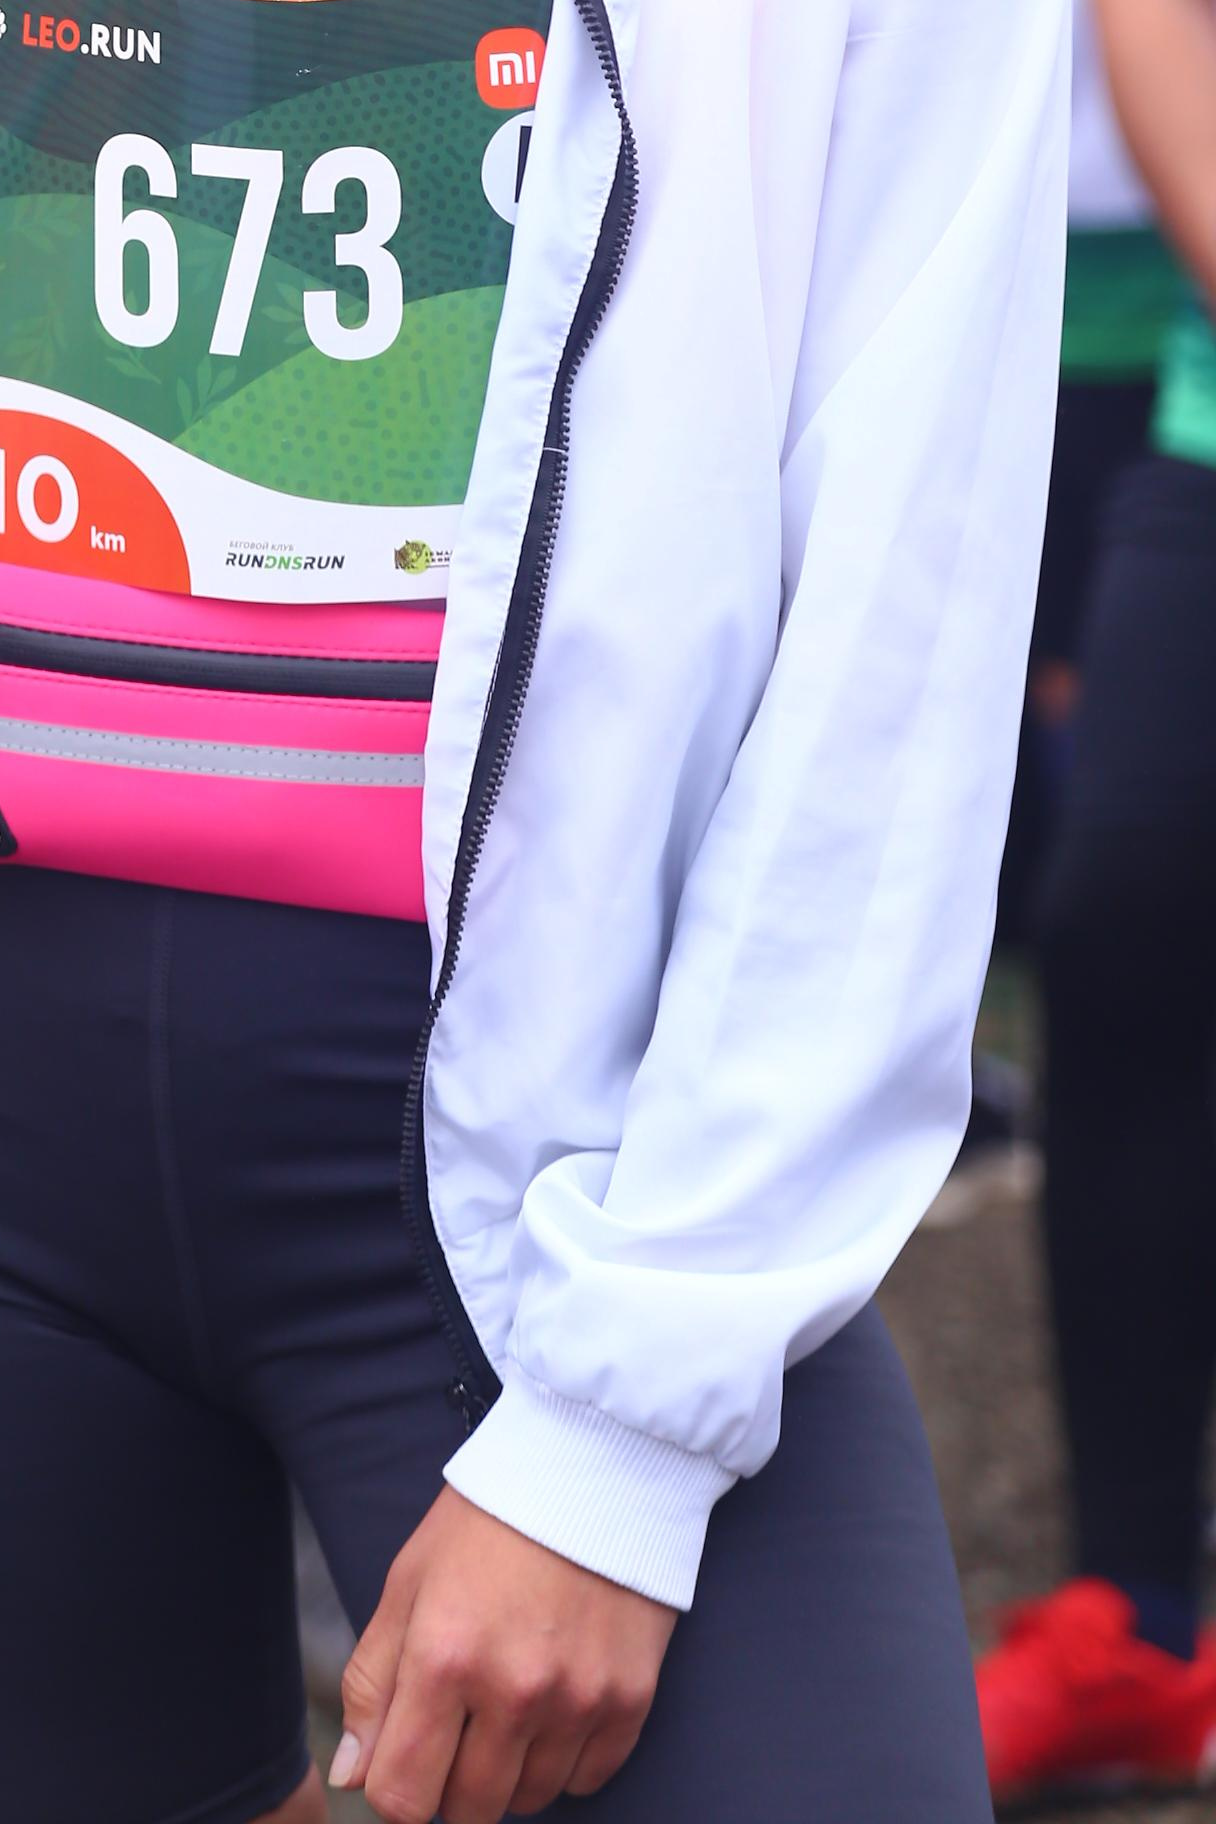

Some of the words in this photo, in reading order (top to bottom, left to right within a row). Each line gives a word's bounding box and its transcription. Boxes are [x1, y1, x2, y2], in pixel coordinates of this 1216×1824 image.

[22, 12, 161, 64] LEO.RUN
[93, 132, 404, 361] 673
[90, 525, 126, 553] km
[225, 552, 345, 570] RUNDNSRUN
